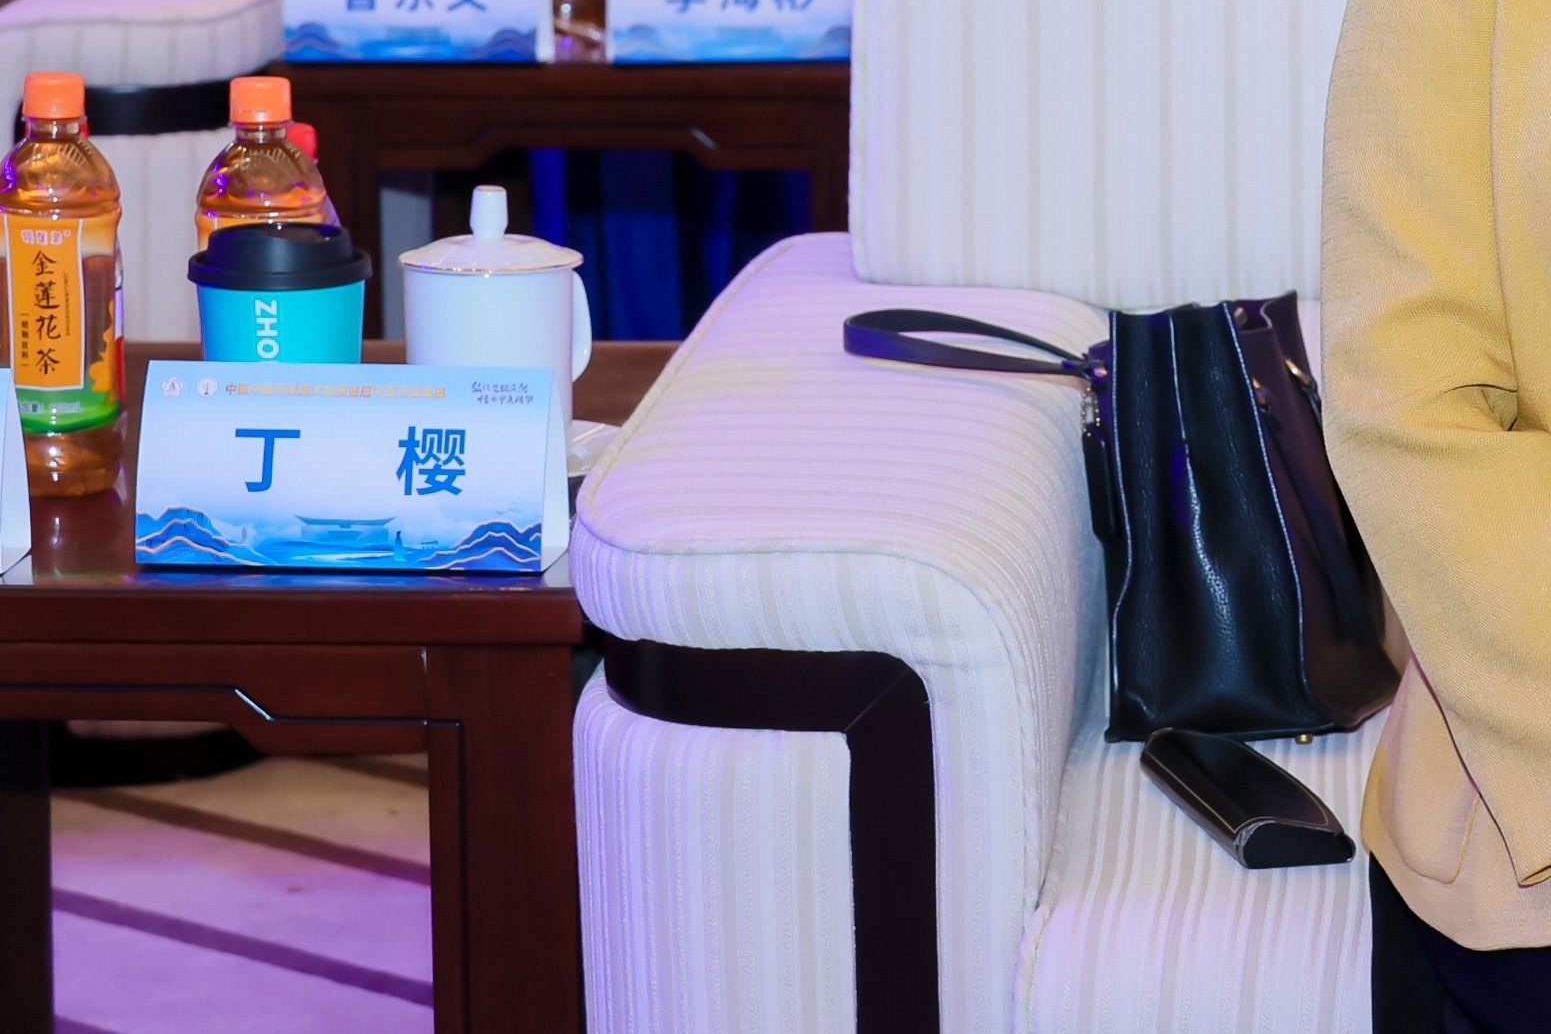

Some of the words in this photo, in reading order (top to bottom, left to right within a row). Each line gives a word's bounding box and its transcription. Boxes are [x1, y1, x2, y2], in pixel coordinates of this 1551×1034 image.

[32, 250, 62, 375] 金莲花茶
[254, 299, 280, 362] ZHO
[234, 427, 301, 493] 丁
[396, 426, 468, 496] 樱
